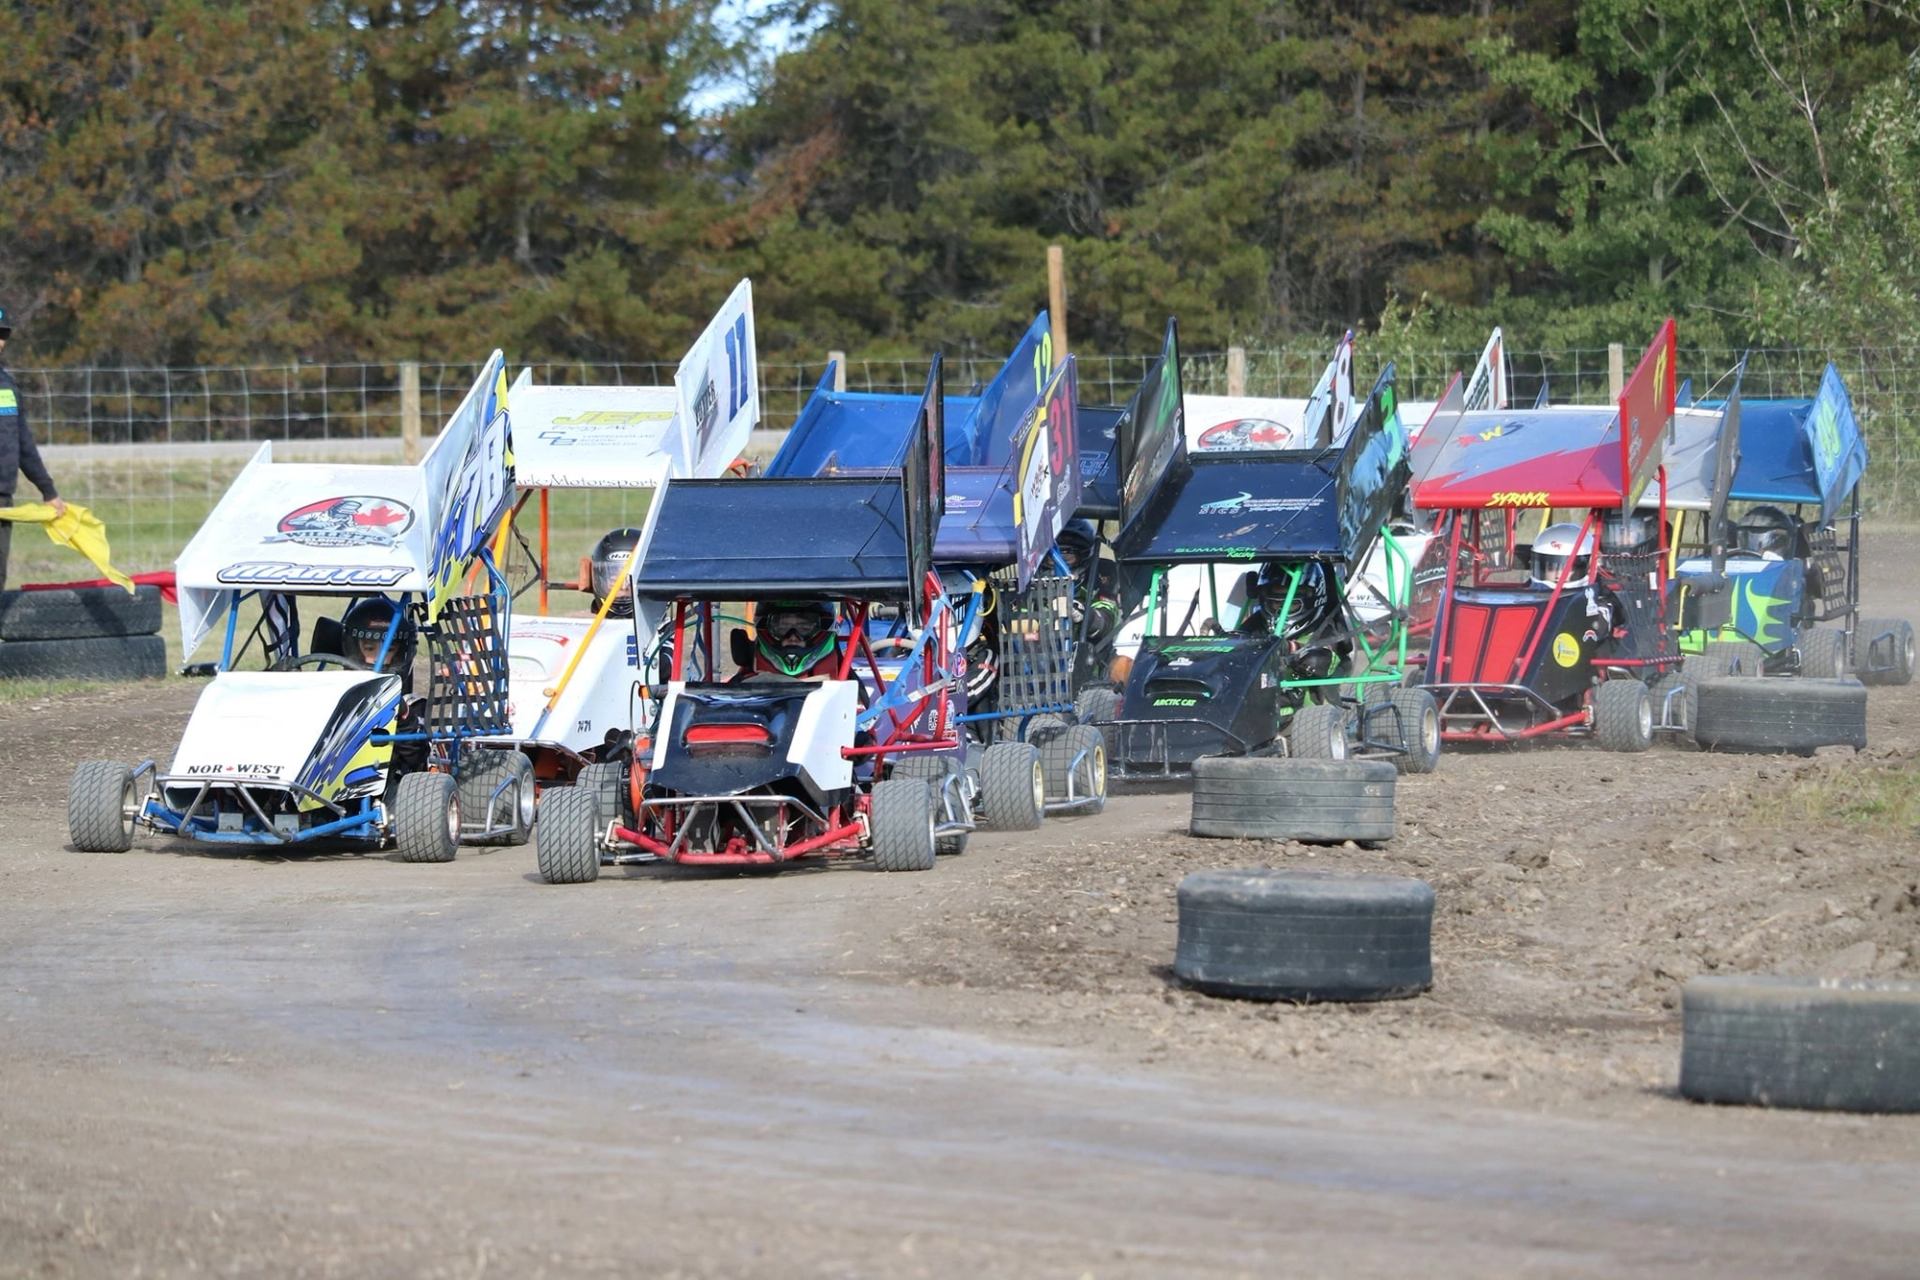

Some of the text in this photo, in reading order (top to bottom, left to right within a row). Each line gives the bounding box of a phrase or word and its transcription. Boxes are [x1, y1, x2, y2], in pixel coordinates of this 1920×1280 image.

[725, 312, 749, 423] 11
[1050, 385, 1073, 476] 31
[461, 411, 507, 560] 78
[1485, 492, 1550, 506] SYRNYK
[218, 562, 414, 586] MARTIN
[1153, 698, 1197, 707] ARCTIC CAT
[187, 763, 285, 775] NOR WEST
